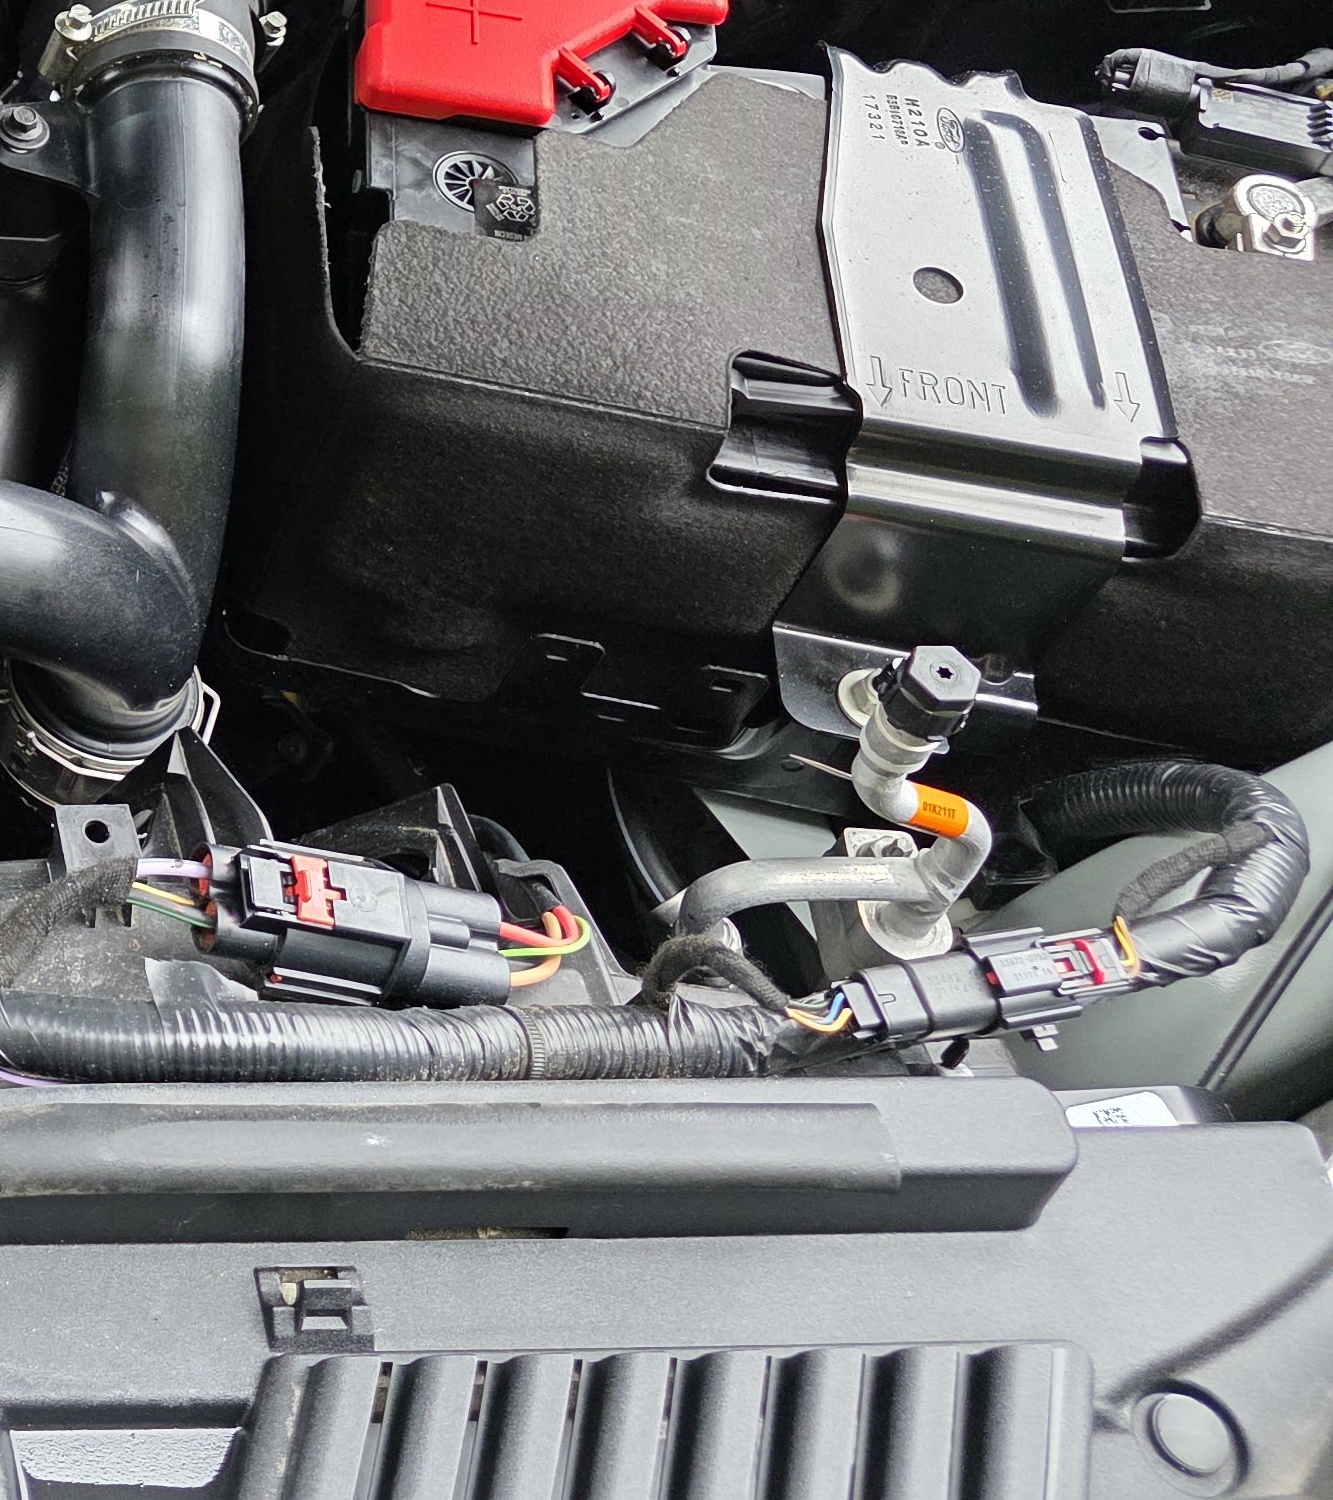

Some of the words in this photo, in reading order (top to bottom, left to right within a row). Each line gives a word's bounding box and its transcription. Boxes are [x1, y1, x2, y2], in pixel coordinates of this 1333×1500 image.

[862, 93, 886, 143] 17321
[903, 96, 932, 149] H210A
[898, 368, 1009, 416] FRONT
